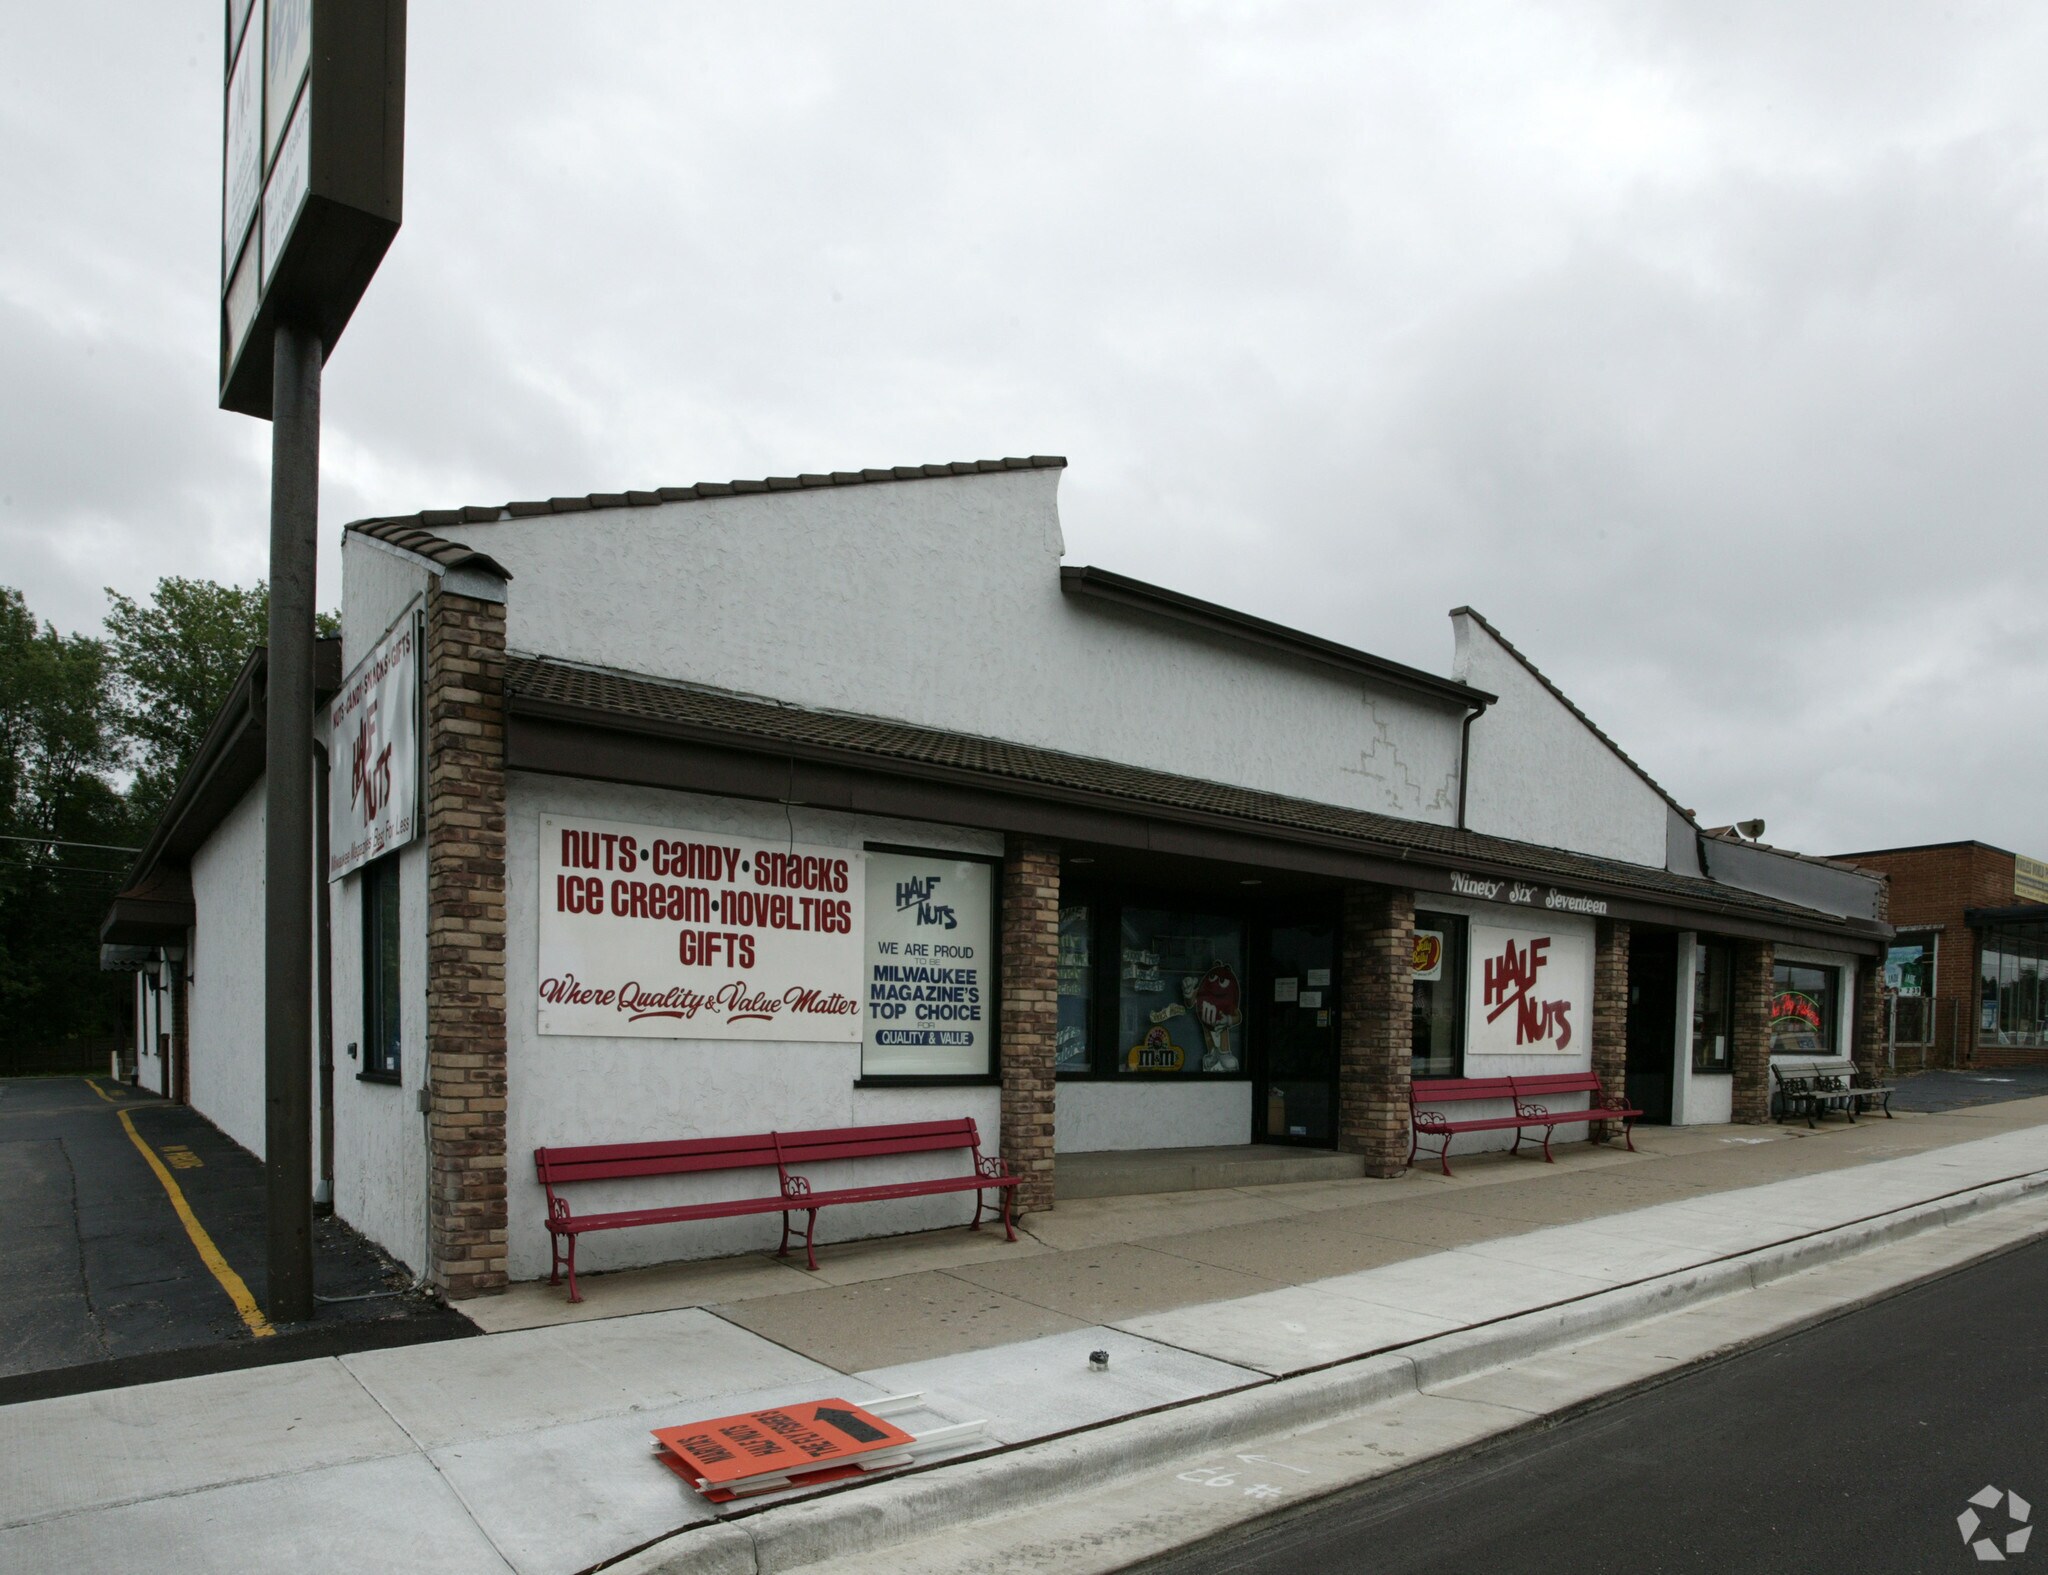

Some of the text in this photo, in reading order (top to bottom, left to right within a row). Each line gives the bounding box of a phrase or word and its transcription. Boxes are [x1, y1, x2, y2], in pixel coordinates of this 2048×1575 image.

[392, 630, 410, 667] GIFTS
[363, 741, 392, 829] NUTS
[896, 875, 941, 907] HALF
[1450, 871, 1607, 914] Ninety Six Seventeen
[916, 902, 957, 930] NUTS
[679, 929, 755, 969] GIFTS
[878, 941, 974, 959] WE ARE PROUD
[914, 957, 941, 966] TO BE
[1483, 937, 1551, 1006] HALF
[874, 965, 977, 985] MILWAUKEE
[539, 973, 860, 1019] Where Quality & Value Matter
[871, 984, 979, 1003] MAGAZINE'S
[869, 1002, 981, 1021] TOP CHOICE
[1516, 990, 1571, 1050] NUTS
[917, 1021, 936, 1029] FOR
[882, 1030, 969, 1045] QUALITY & VALUE
[738, 1439, 786, 1457] HALF
[799, 1440, 842, 1457] THE
